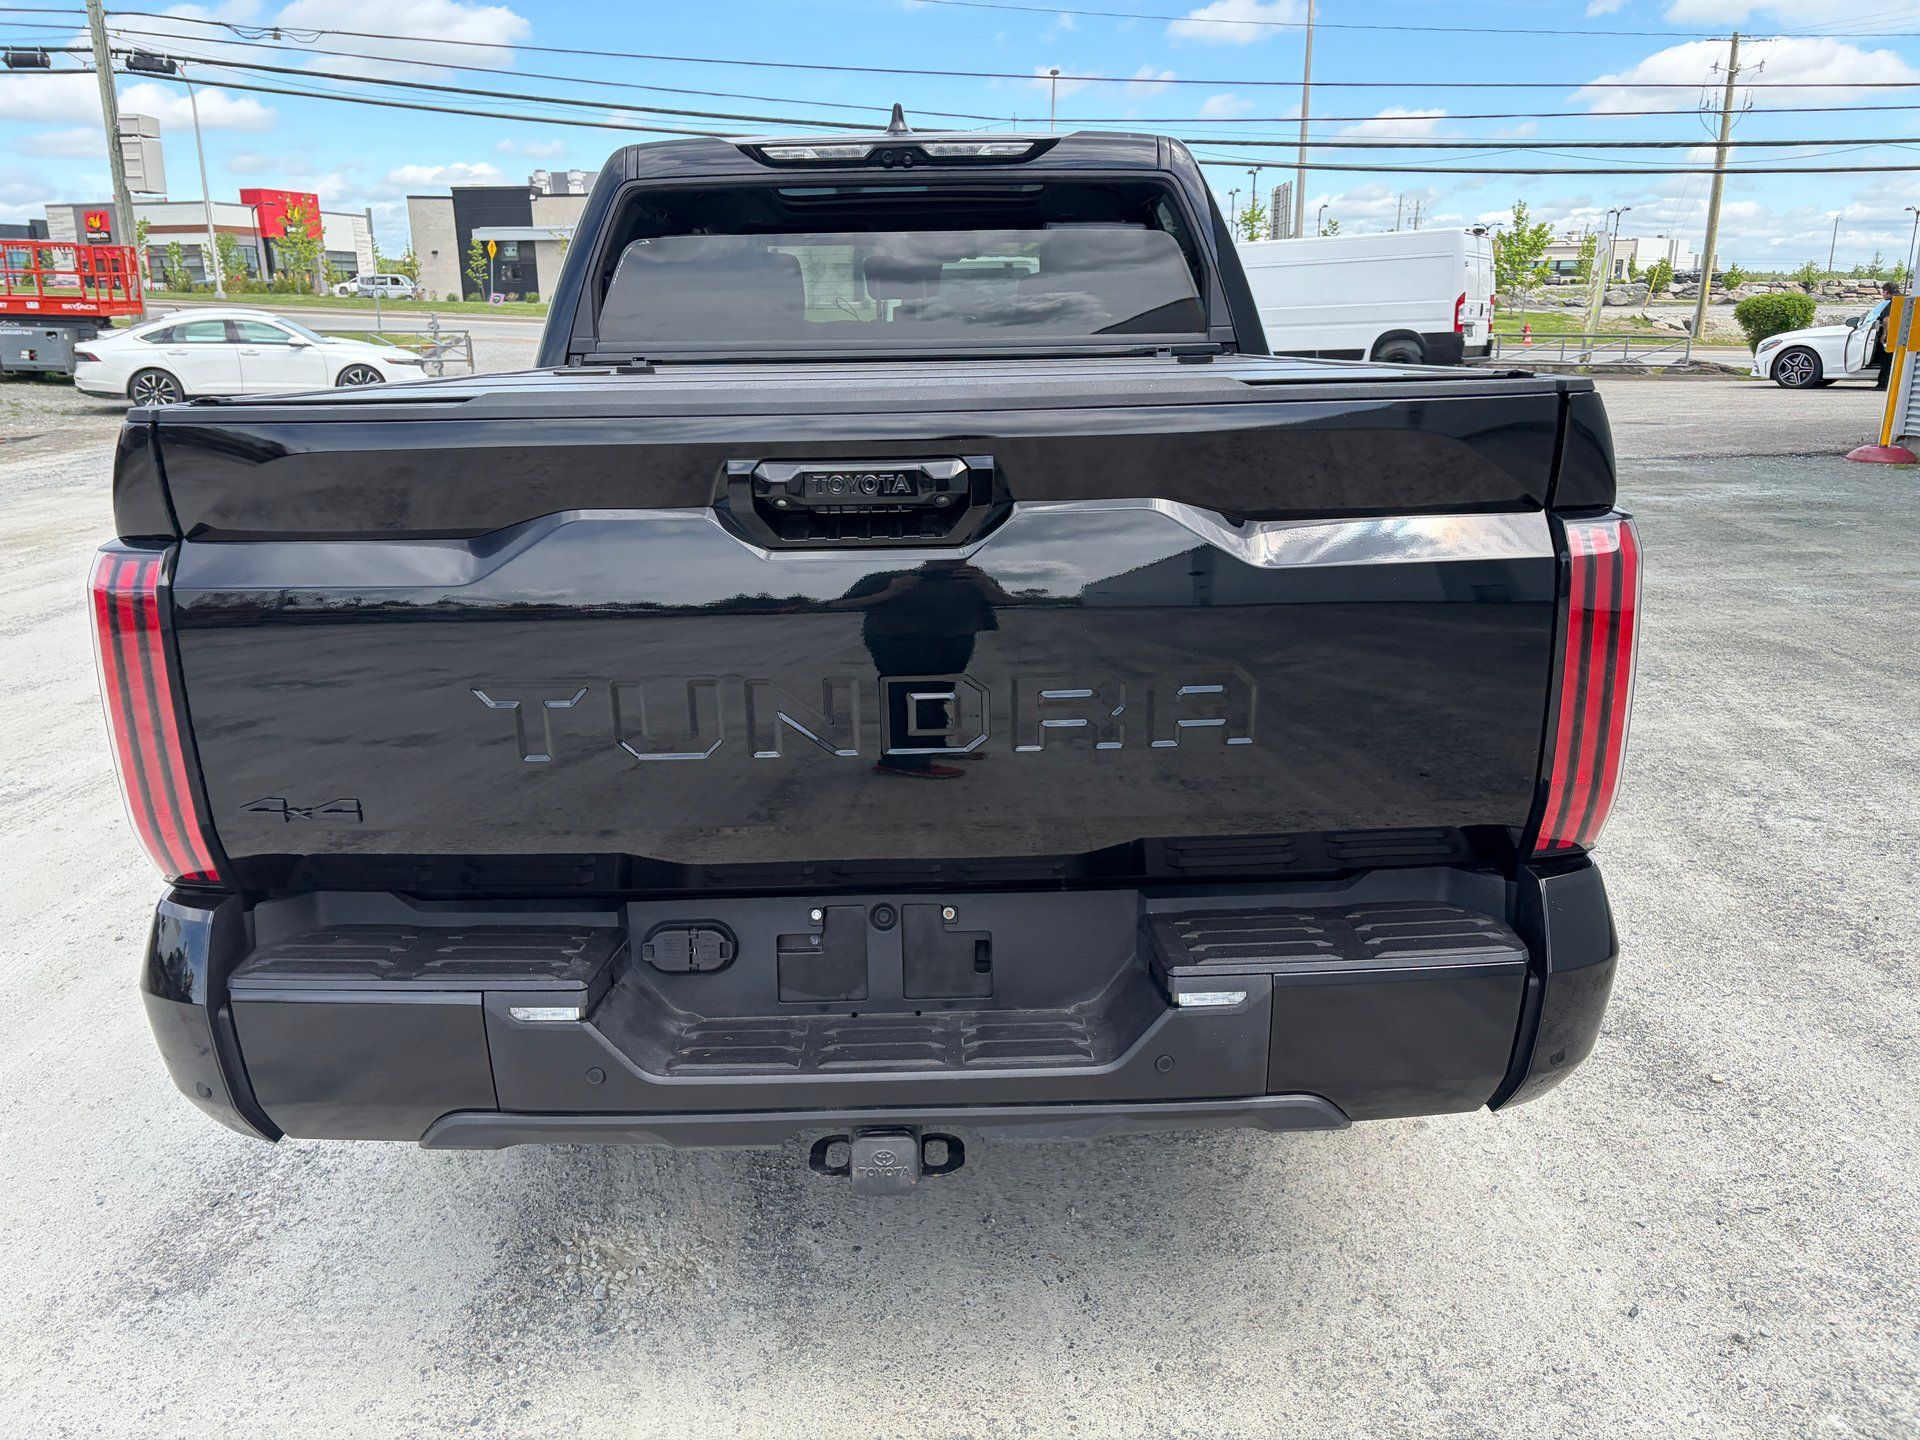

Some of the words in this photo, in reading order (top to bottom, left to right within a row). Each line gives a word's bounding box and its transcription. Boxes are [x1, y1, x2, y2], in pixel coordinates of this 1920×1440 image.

[61, 302, 98, 311] SKYJACK
[811, 473, 911, 496] TOYOTA
[470, 665, 1259, 763] TUNDRA
[239, 796, 364, 824] 4x4
[854, 1165, 912, 1179] TOYOTA
